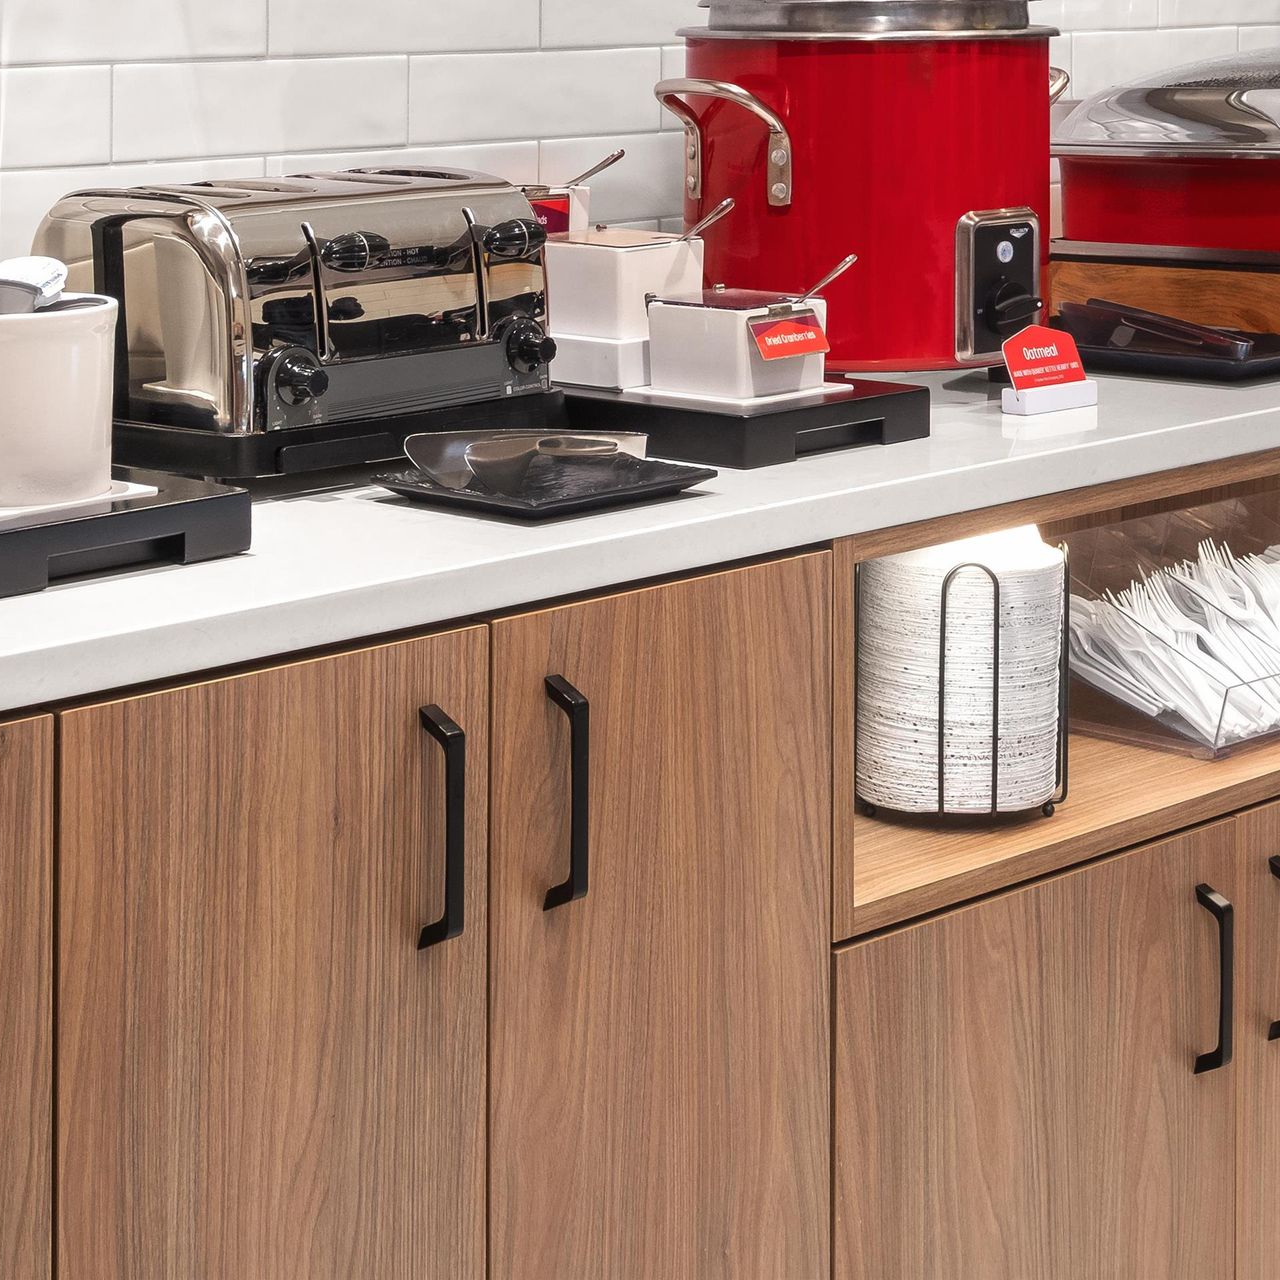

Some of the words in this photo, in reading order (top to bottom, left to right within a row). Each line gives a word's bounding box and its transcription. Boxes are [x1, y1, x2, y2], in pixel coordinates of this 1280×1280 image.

[765, 333, 782, 346] Dried
[780, 330, 816, 345] Cranberries
[1023, 343, 1058, 360] Oatmeal
